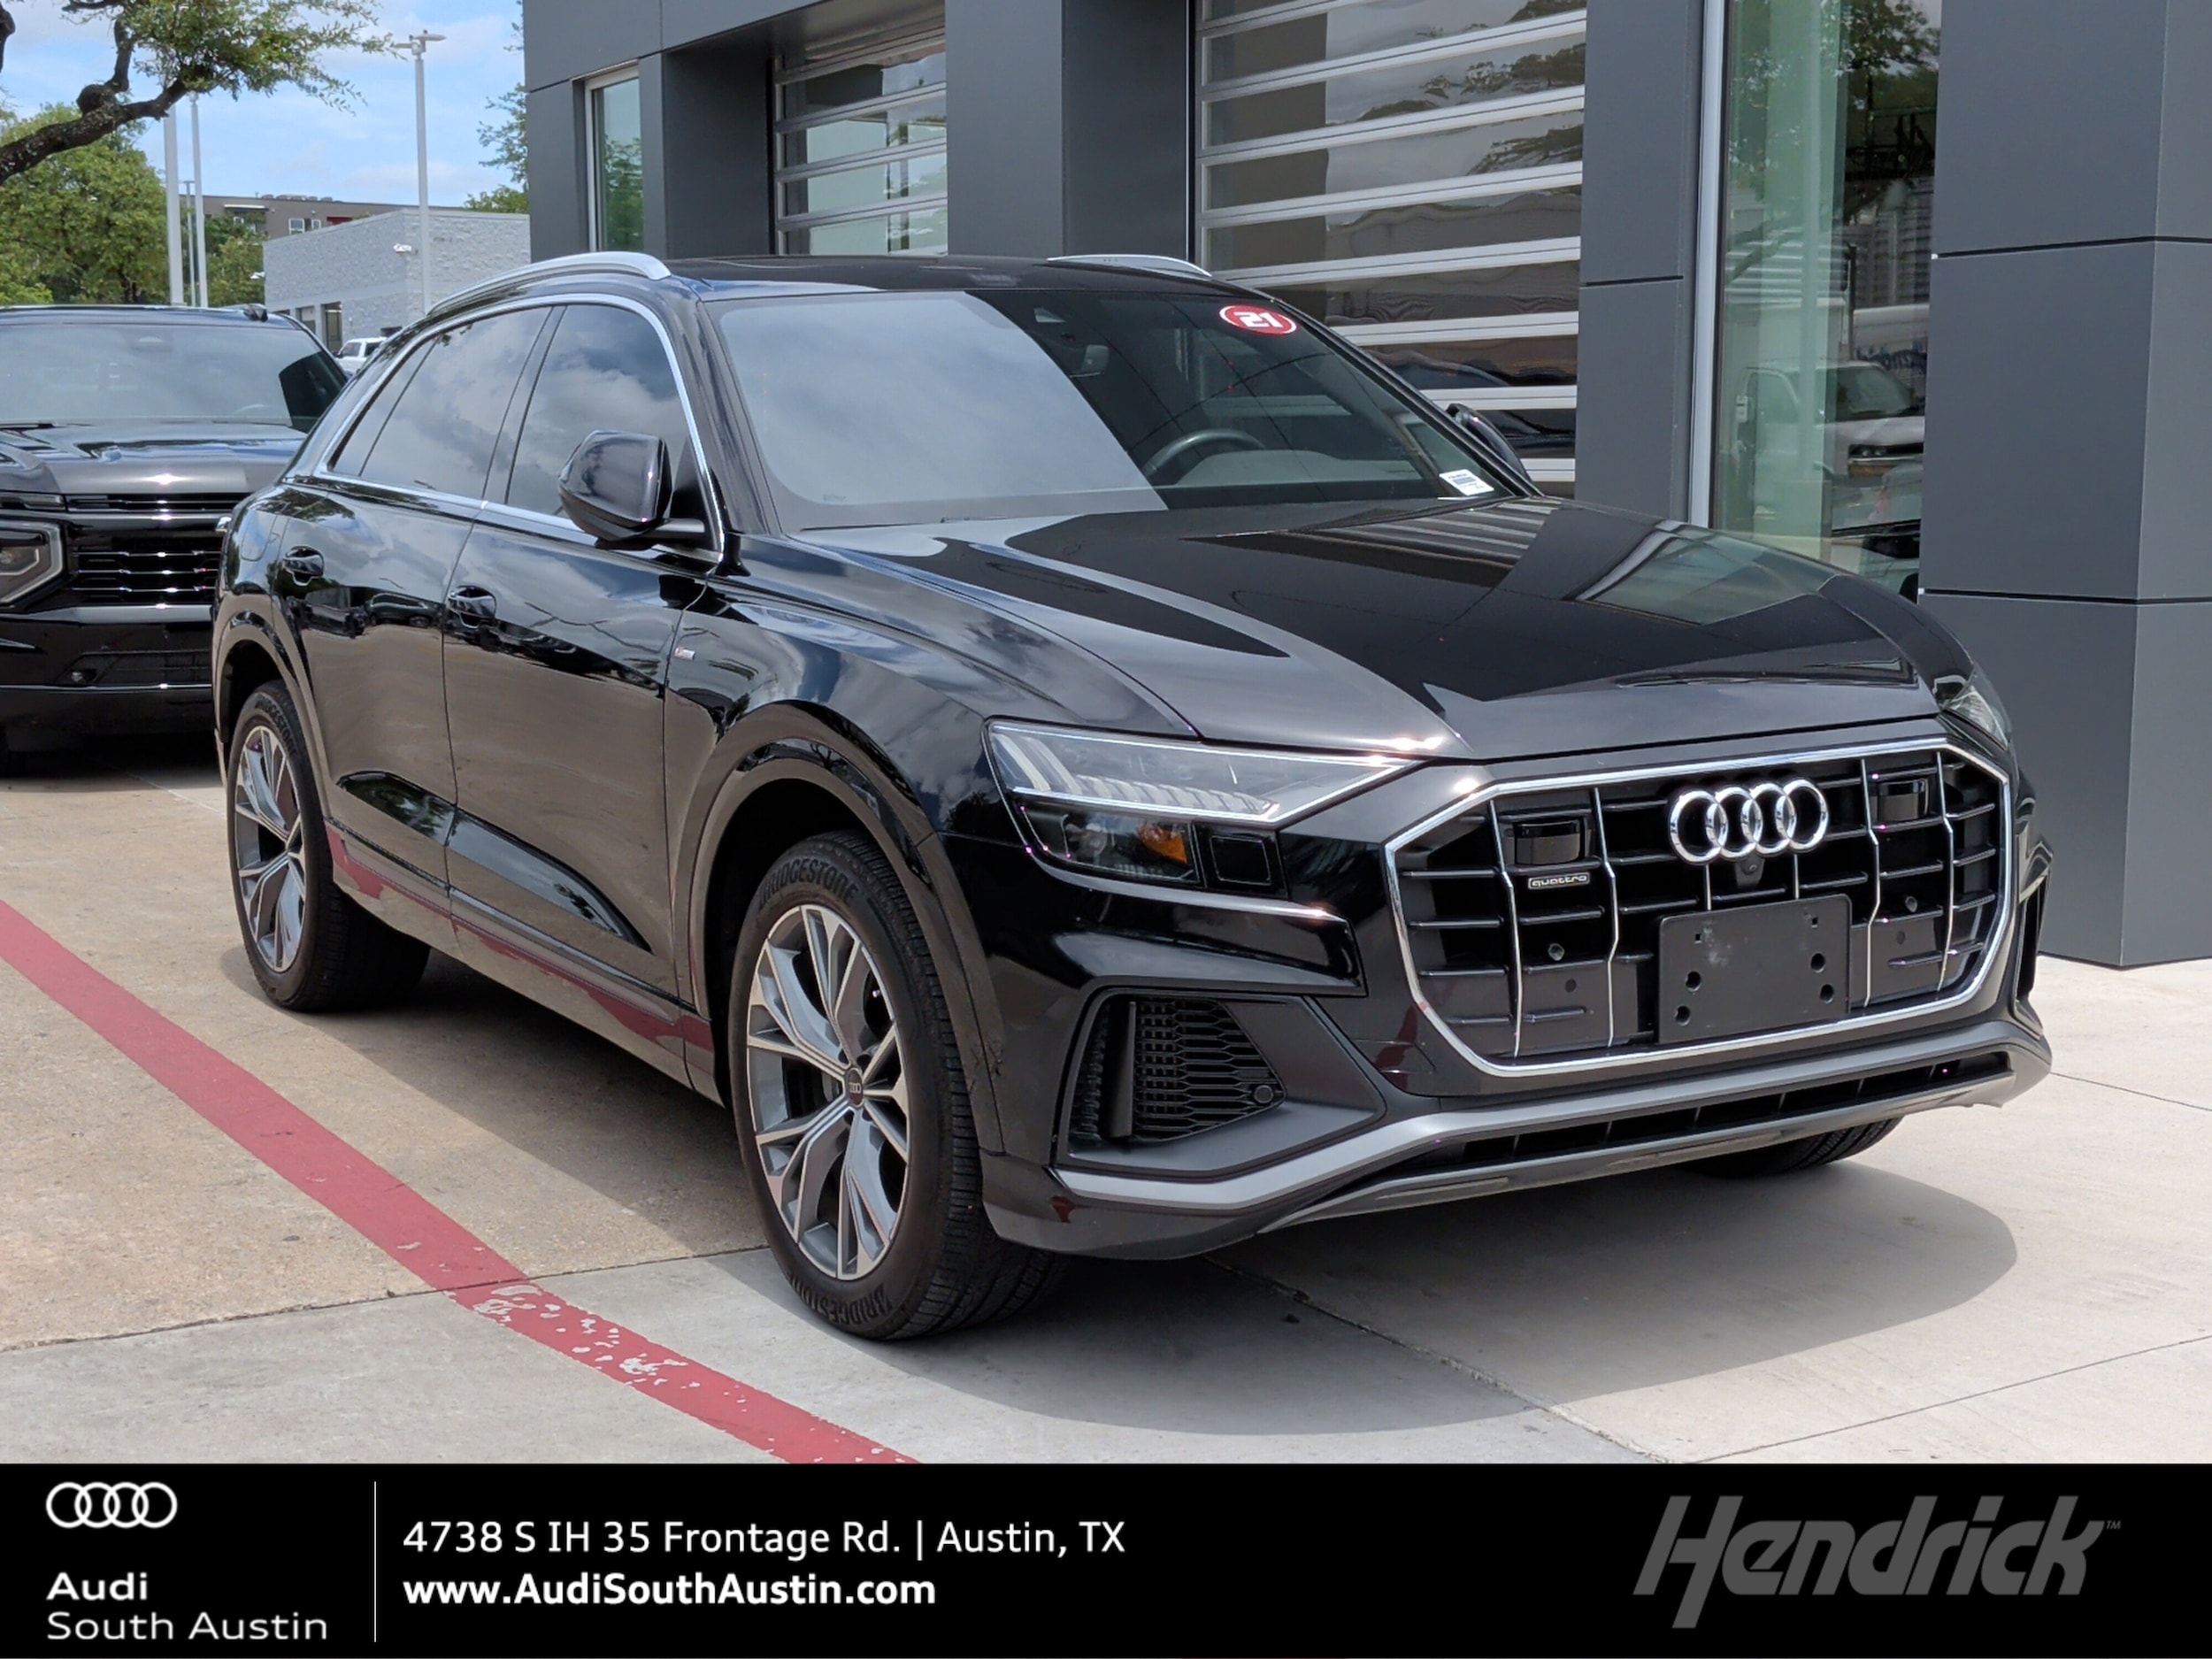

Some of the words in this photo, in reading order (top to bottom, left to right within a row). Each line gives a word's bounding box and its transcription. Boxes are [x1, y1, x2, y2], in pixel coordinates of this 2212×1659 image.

[1233, 311, 1284, 328] 21
[758, 858, 859, 909] BRIDGESTONE
[1531, 874, 1587, 888] quattro
